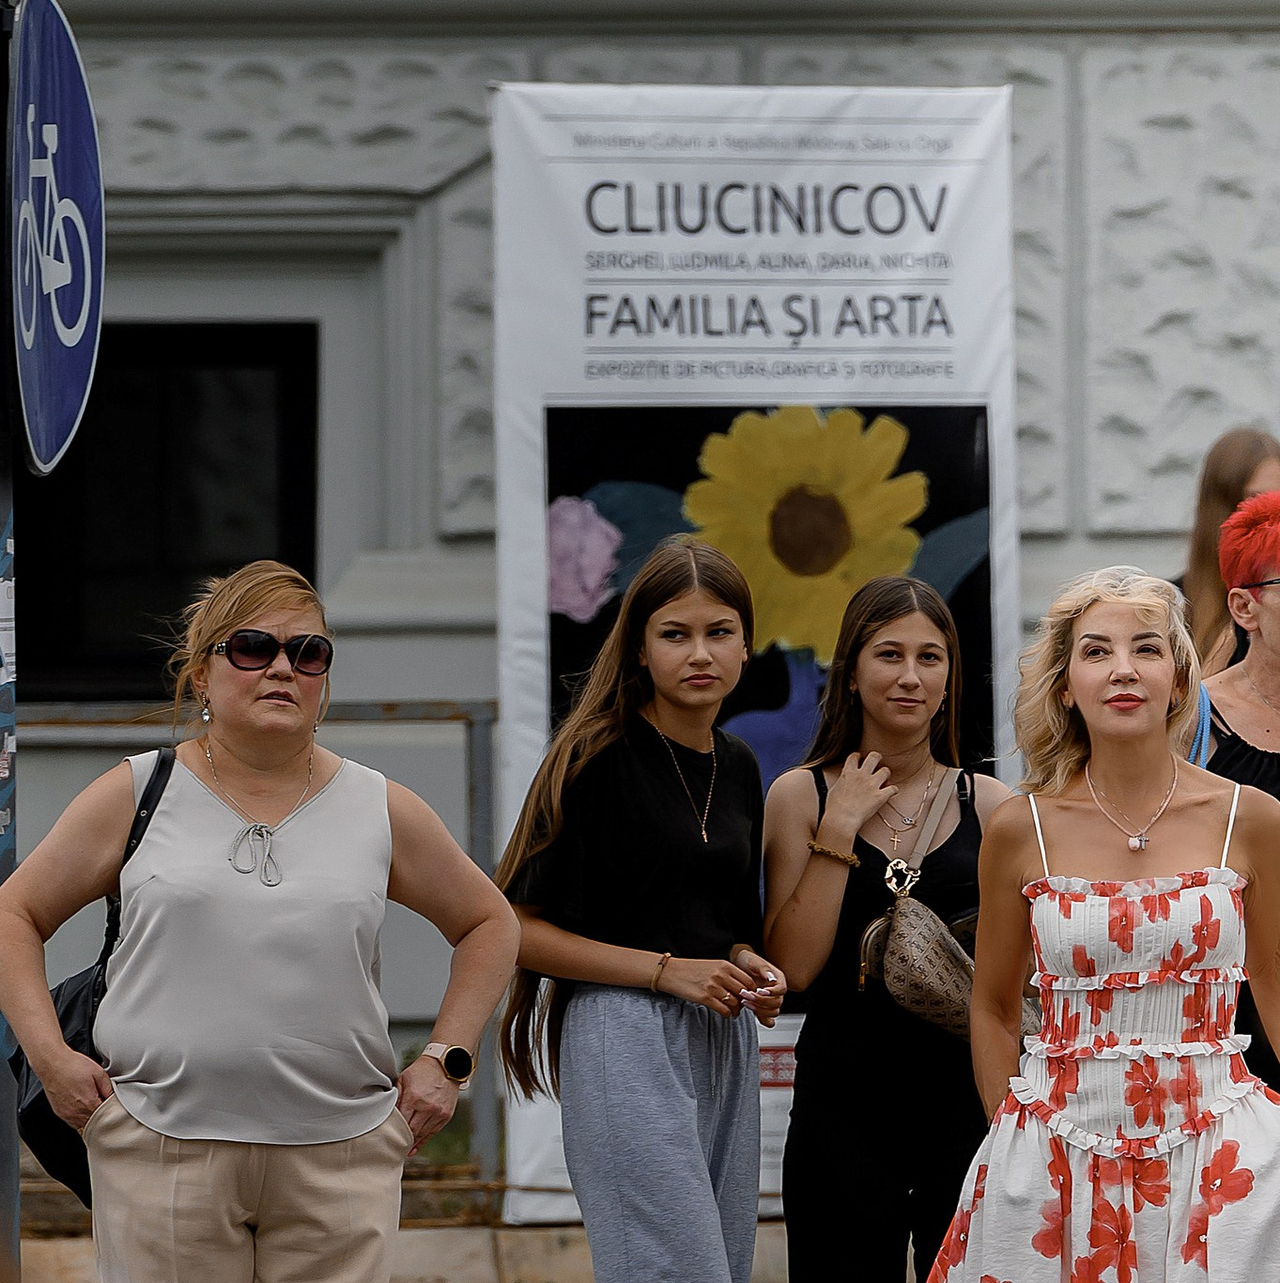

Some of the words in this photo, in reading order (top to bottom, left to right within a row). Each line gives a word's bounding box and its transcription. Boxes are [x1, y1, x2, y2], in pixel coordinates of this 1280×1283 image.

[585, 181, 948, 235] CLIUCINICOV
[584, 293, 772, 338] FAMILIA
[834, 294, 954, 338] ARTA
